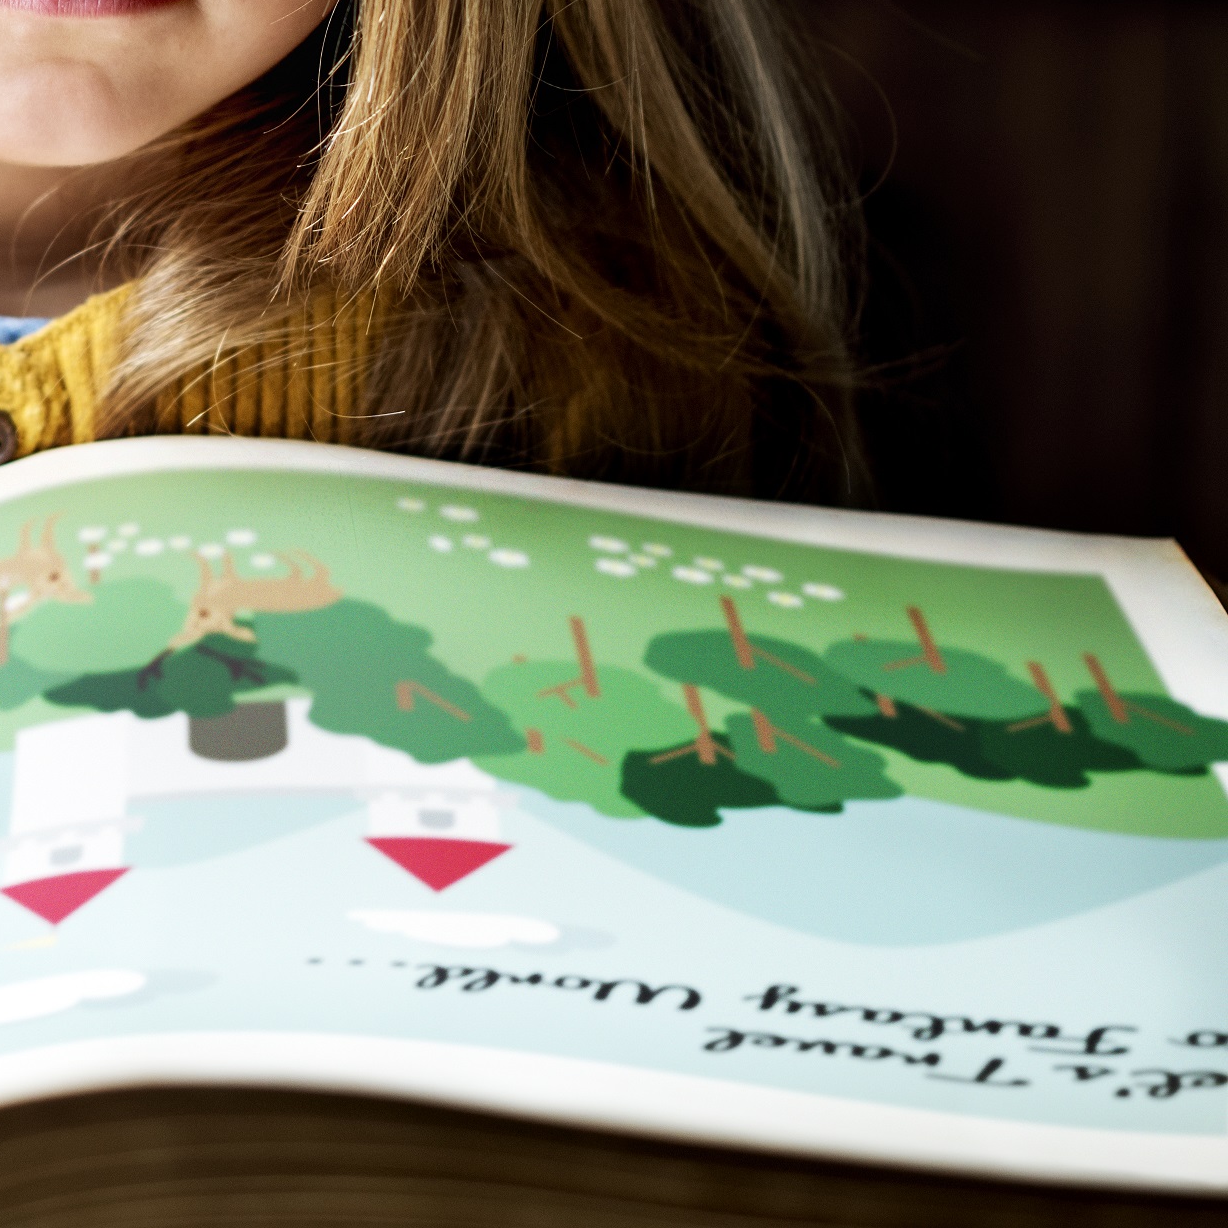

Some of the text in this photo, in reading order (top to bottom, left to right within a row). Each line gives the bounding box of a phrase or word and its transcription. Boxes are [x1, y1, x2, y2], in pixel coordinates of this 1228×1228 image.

[742, 984, 1138, 1057] Fantasy
[1167, 1029, 1228, 1050] o
[703, 1026, 1228, 1101] et's Travel
